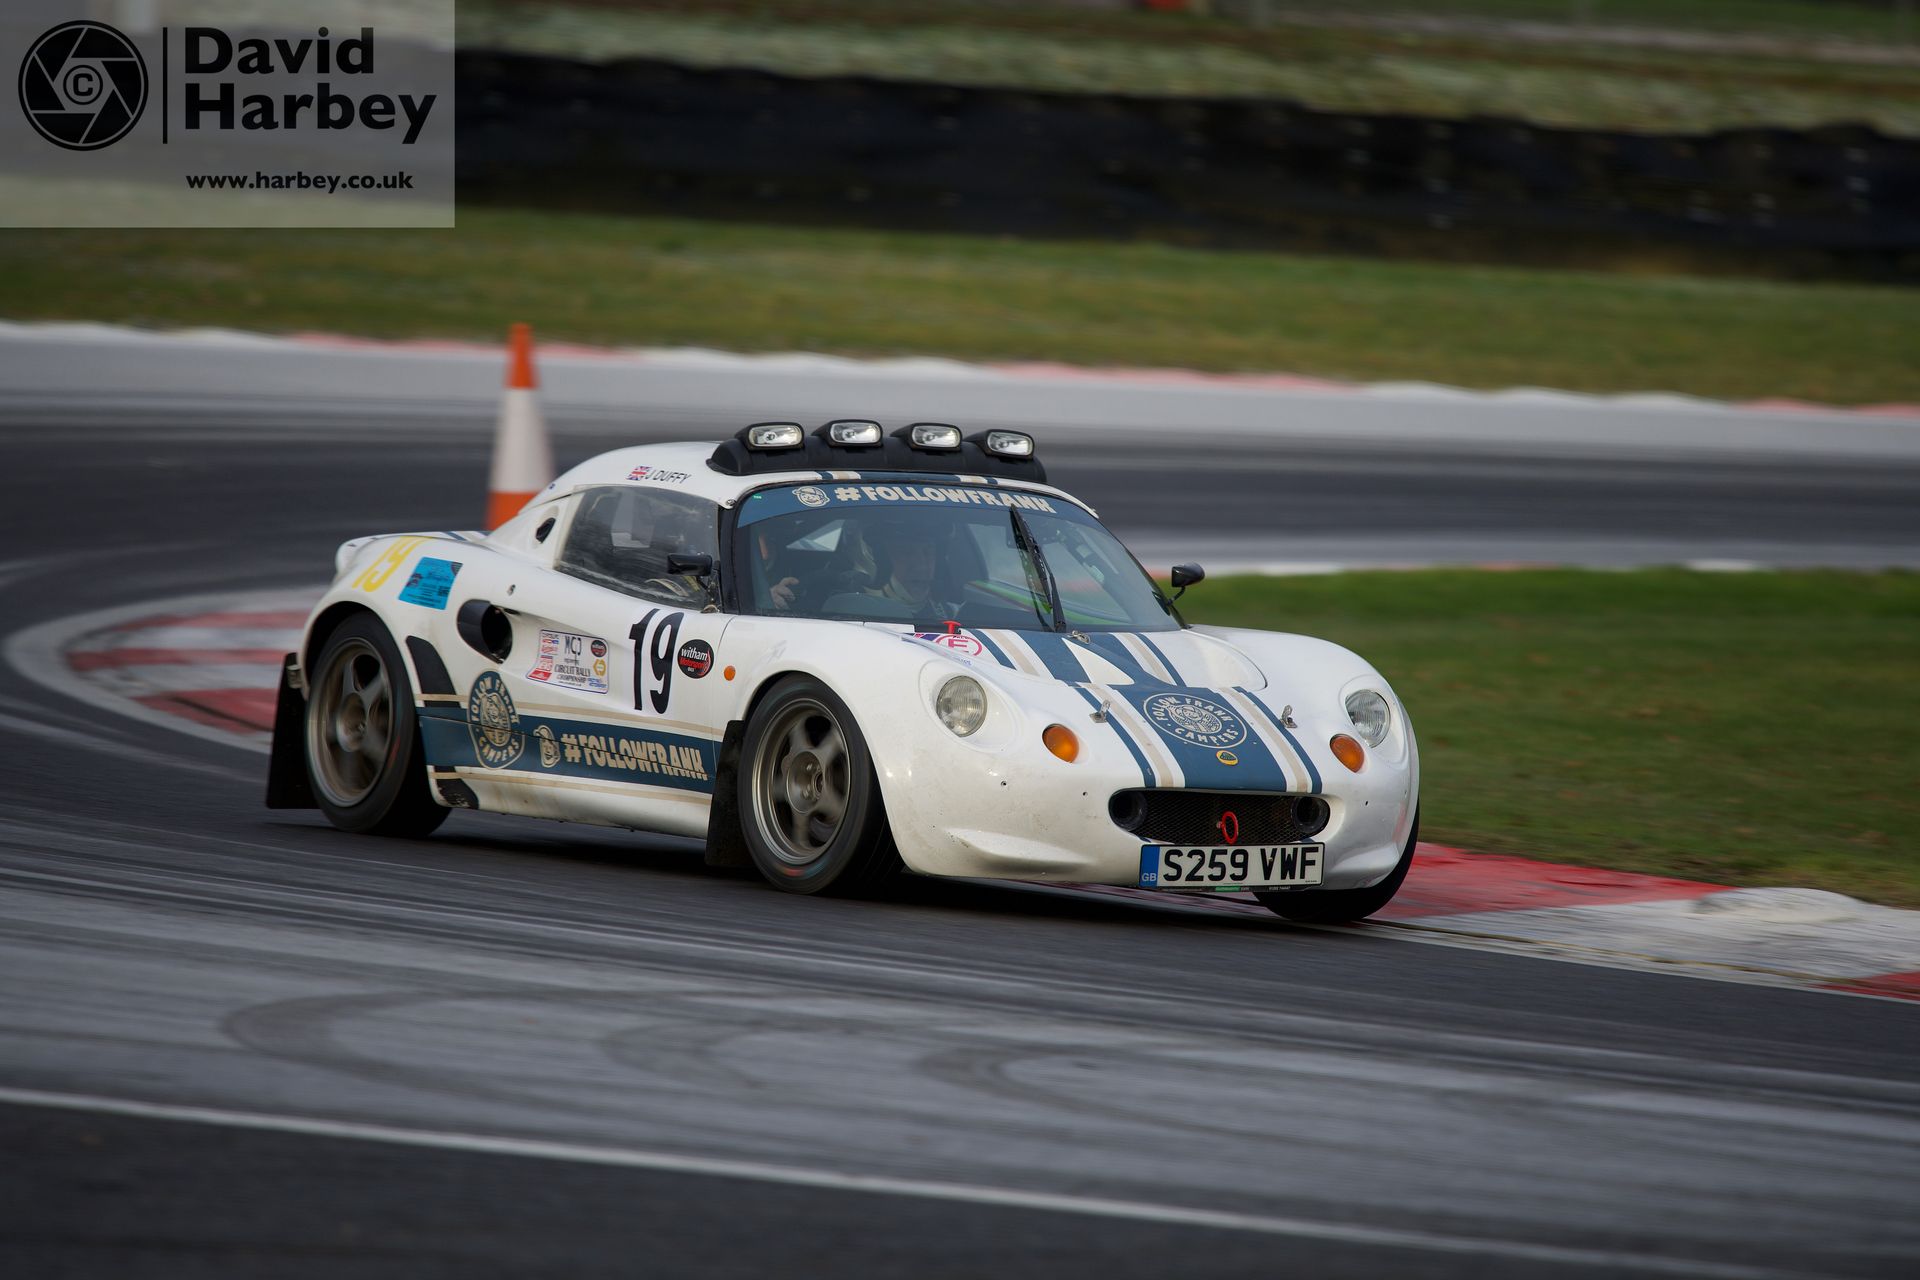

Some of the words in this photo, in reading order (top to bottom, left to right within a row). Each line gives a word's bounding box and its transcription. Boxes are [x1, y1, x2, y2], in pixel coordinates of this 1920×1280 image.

[653, 470, 693, 484] DUFFY
[629, 608, 685, 715] 19
[681, 646, 708, 661] witham
[1152, 696, 1178, 721] FOLLOW
[1185, 697, 1234, 722] FRANK
[1174, 727, 1240, 746] CAMPERS
[1141, 872, 1157, 882] GB
[1163, 848, 1249, 882] S259
[1260, 846, 1320, 881] VWF
